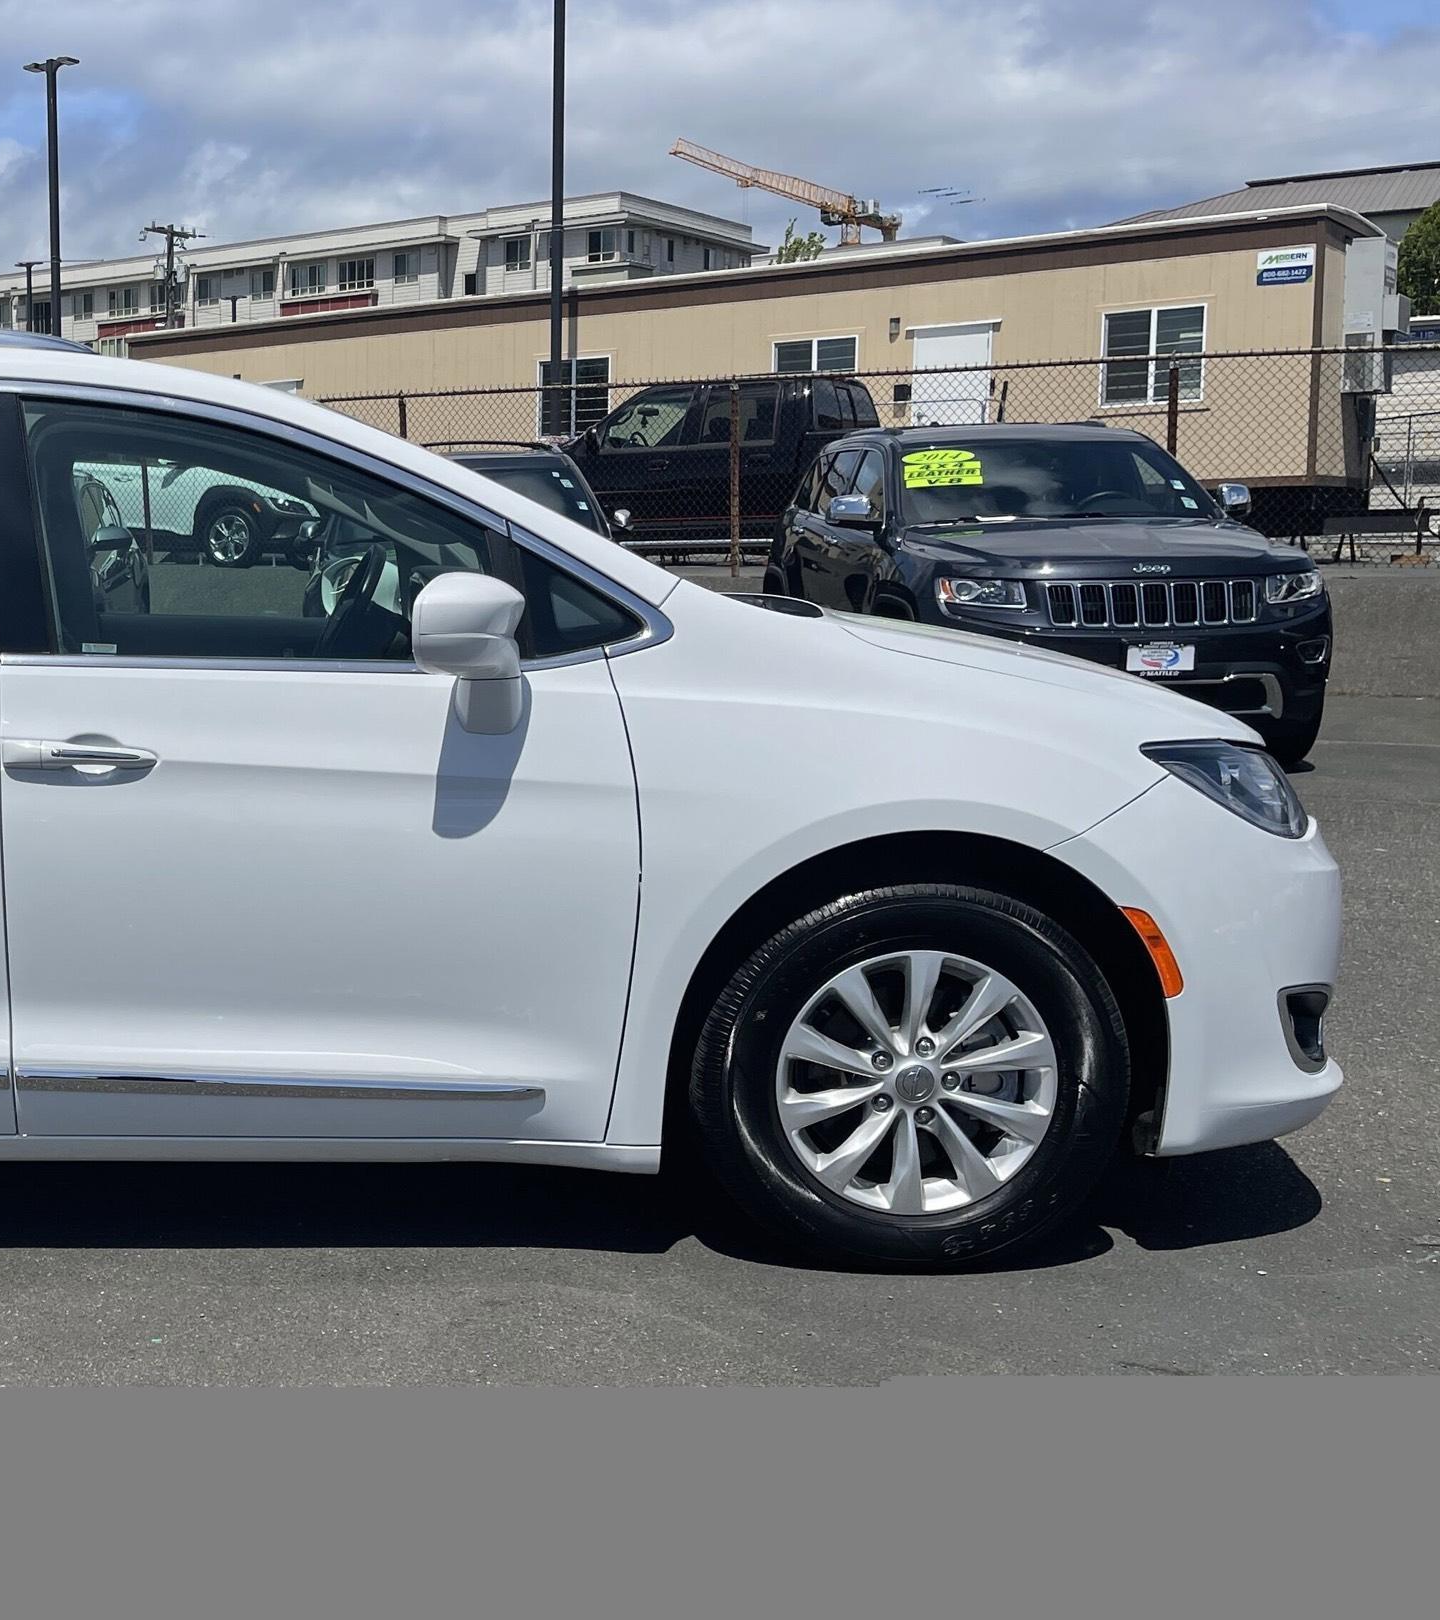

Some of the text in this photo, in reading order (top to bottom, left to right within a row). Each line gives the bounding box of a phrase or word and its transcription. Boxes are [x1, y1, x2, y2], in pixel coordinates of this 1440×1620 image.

[1262, 252, 1308, 265] MODERN
[914, 452, 962, 462] 2014
[907, 469, 976, 479] LEATHER
[1133, 563, 1171, 574] Jeep
